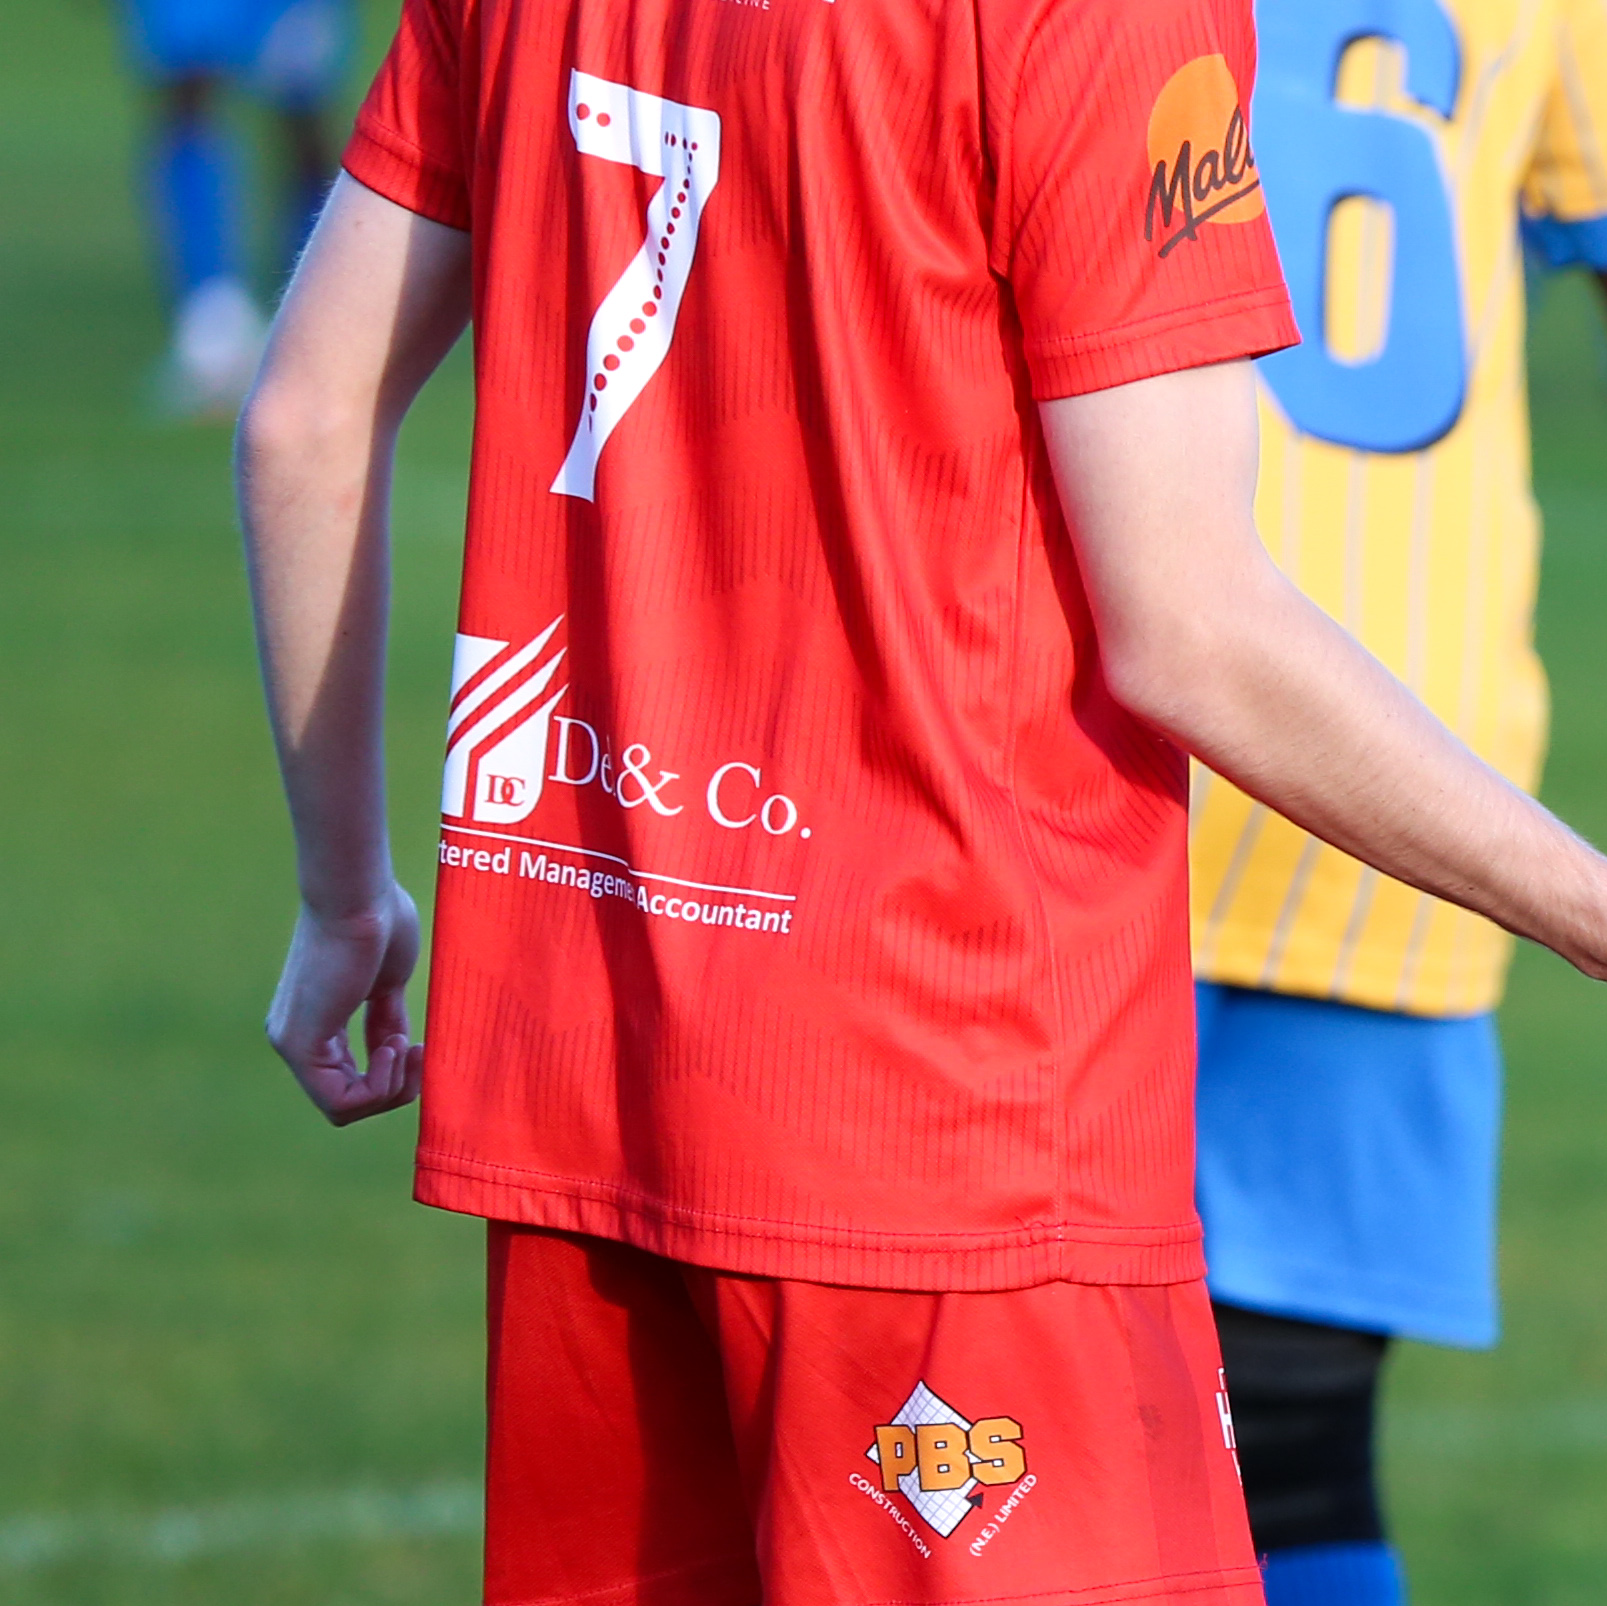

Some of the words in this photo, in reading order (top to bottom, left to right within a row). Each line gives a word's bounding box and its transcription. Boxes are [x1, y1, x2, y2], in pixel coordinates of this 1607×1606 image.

[1251, 0, 1467, 455] 6
[549, 67, 721, 504] 7
[484, 773, 526, 806] DC
[617, 743, 684, 816] &
[706, 761, 812, 839] Co.
[636, 885, 793, 934] Accountant
[873, 1415, 1028, 1493] PBS
[848, 1472, 932, 1559] CONSTRUCTION
[969, 1522, 1001, 1557] (N.E.)
[994, 1473, 1038, 1523] LIMITED
